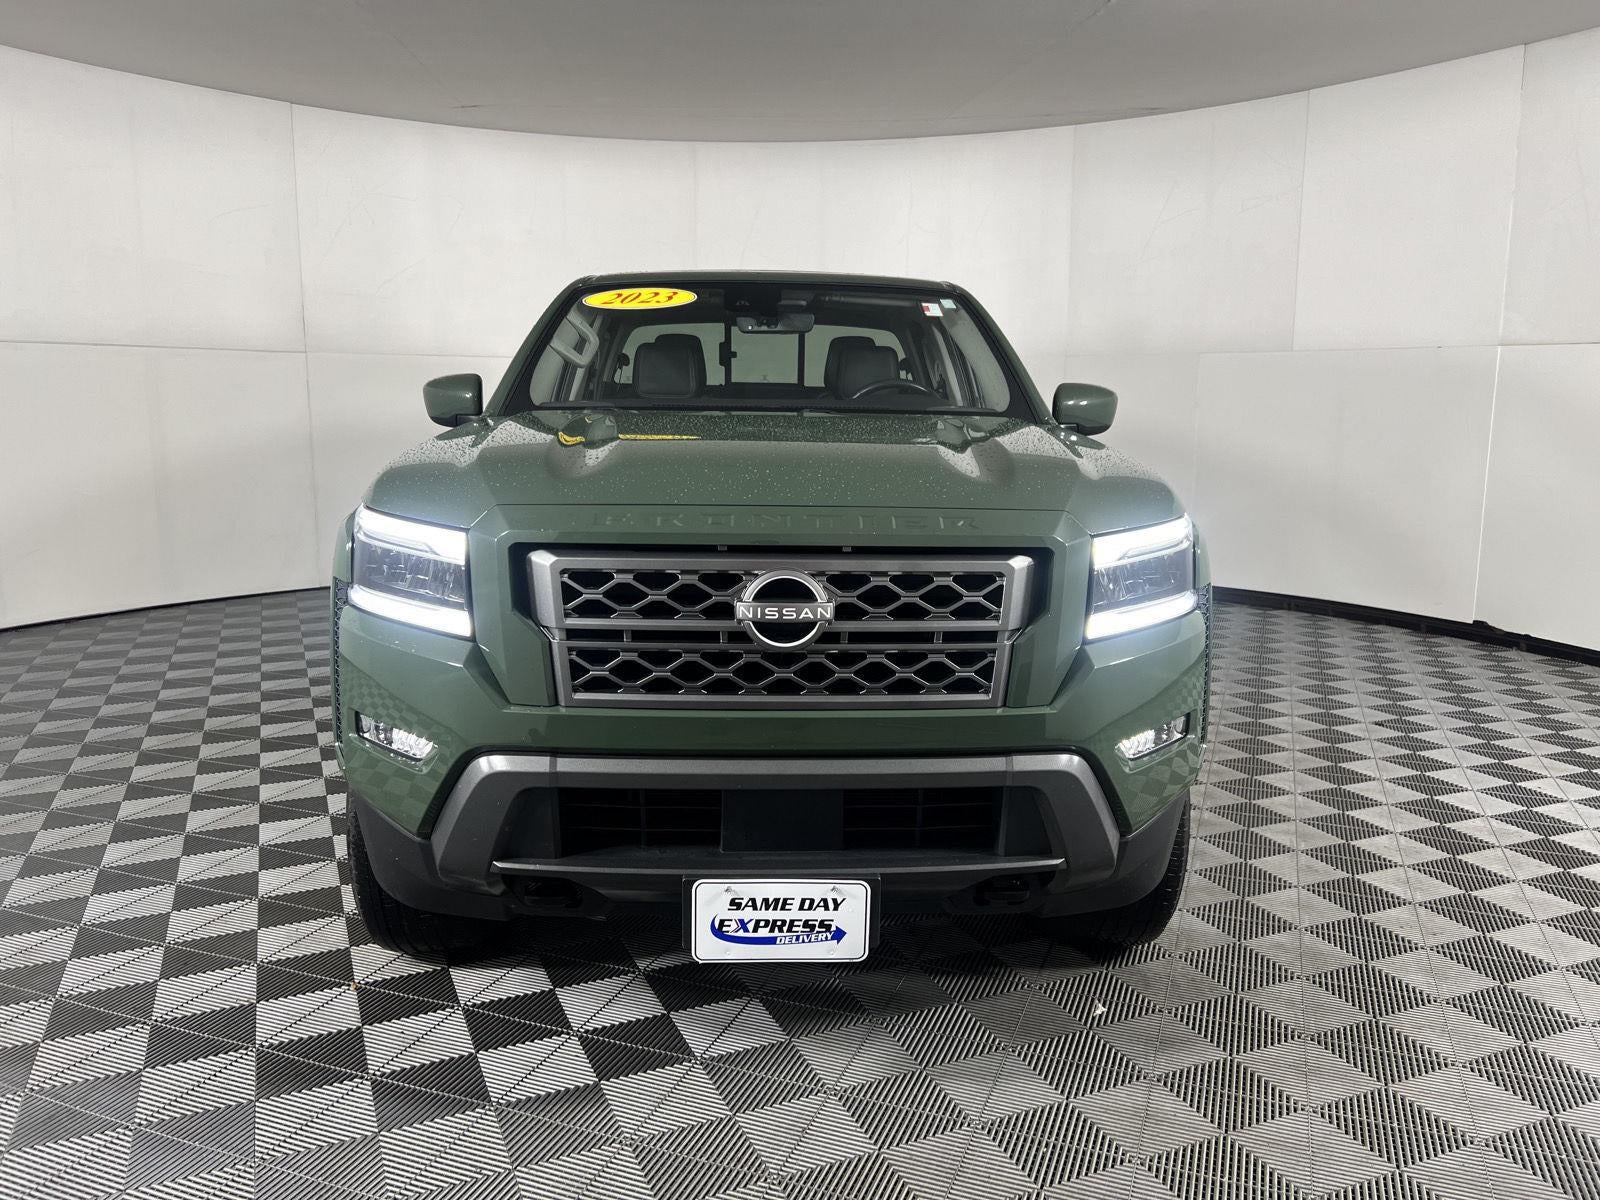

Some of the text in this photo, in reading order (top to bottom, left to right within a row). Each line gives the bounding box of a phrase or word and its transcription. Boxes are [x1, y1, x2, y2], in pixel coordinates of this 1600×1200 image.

[601, 291, 679, 304] 2023
[739, 607, 831, 619] NISSAN
[727, 897, 847, 911] SAME DAY
[717, 918, 834, 933] EXPRESS
[775, 931, 835, 945] DELIVERY
